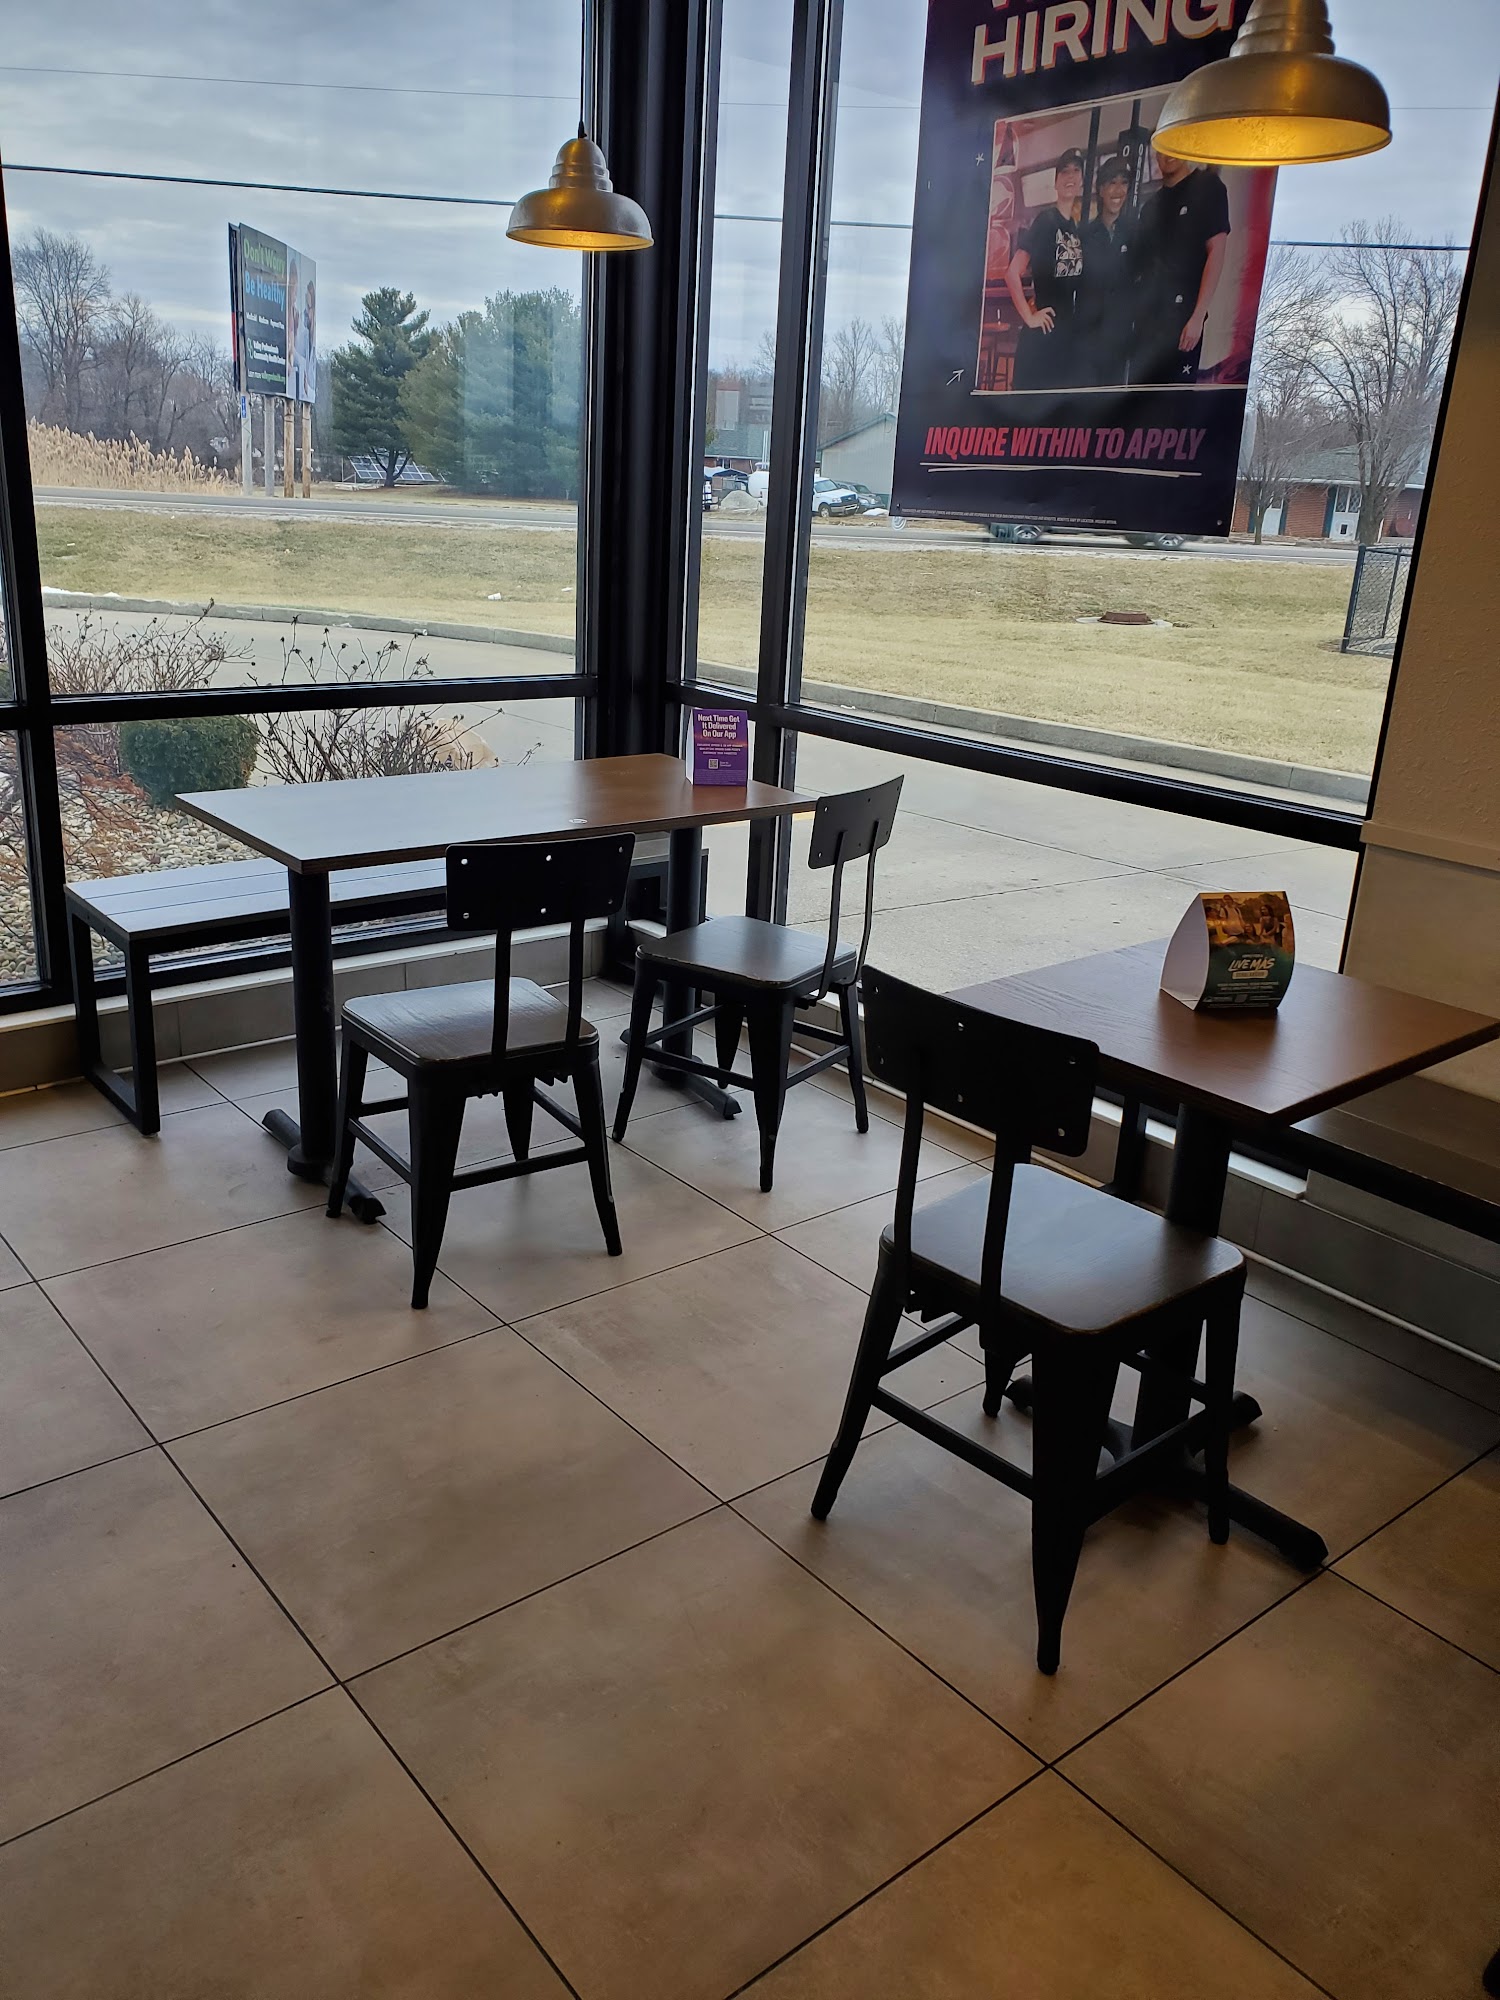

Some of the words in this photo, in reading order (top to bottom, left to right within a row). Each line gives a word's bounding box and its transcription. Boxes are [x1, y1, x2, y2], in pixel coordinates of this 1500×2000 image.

[971, 0, 1233, 85] HIRING
[244, 238, 265, 265] Don't
[265, 247, 285, 278] Worry
[245, 271, 255, 296] Be
[257, 275, 285, 311] Healthy
[925, 427, 1008, 460] INQUIRE
[1010, 427, 1092, 458] WITHIN
[1095, 428, 1126, 459] TO
[1126, 428, 1207, 460] APPLY
[698, 714, 713, 722] Next
[713, 714, 728, 722] Time
[729, 715, 740, 723] Get
[708, 722, 736, 730] Delivered
[724, 731, 736, 739] App
[1228, 959, 1250, 972] LIVE
